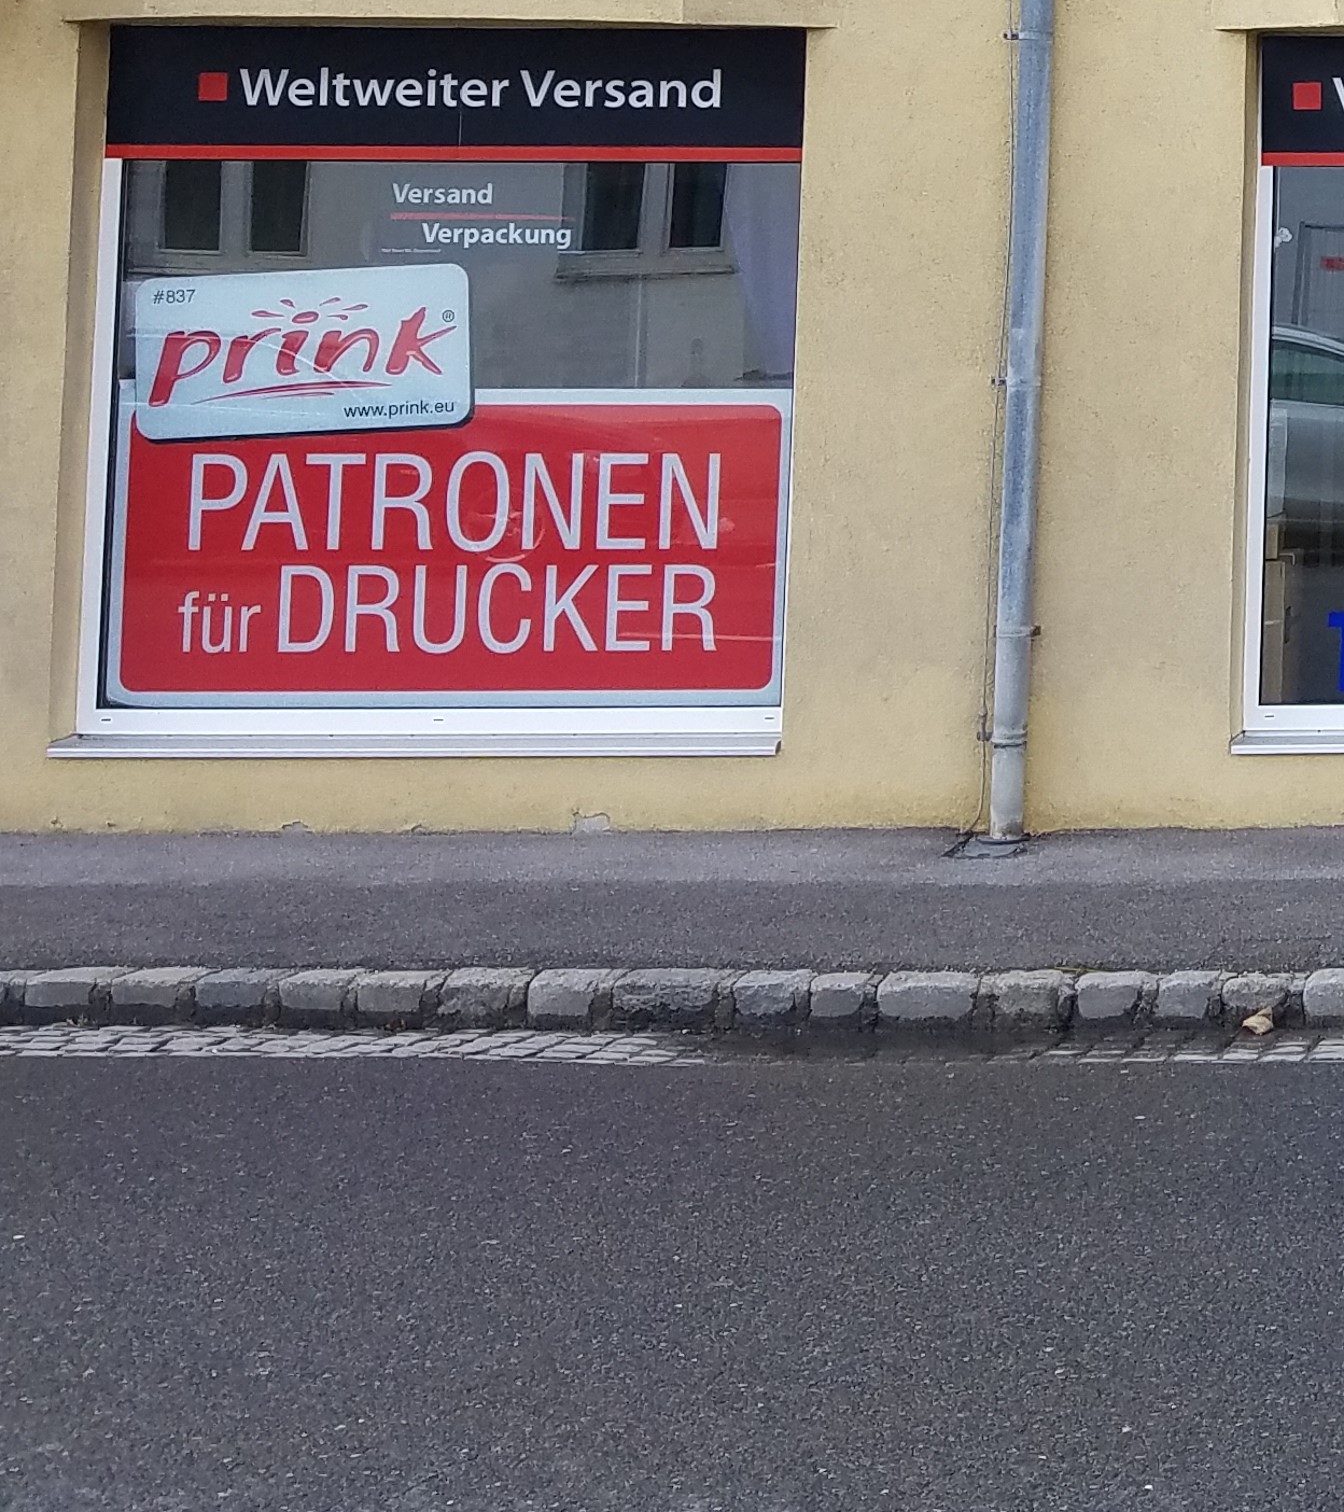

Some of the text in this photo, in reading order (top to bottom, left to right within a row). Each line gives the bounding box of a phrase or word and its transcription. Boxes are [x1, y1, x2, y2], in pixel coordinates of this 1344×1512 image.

[239, 67, 723, 109] Weltweiter Versand
[393, 183, 493, 204] Versand
[422, 222, 572, 249] Verpackung
[152, 289, 196, 304] #837
[148, 307, 457, 407] prink
[343, 400, 455, 420] www.prink.eu
[187, 451, 721, 552] PATRONEN
[178, 564, 718, 654] für DRUCKER
